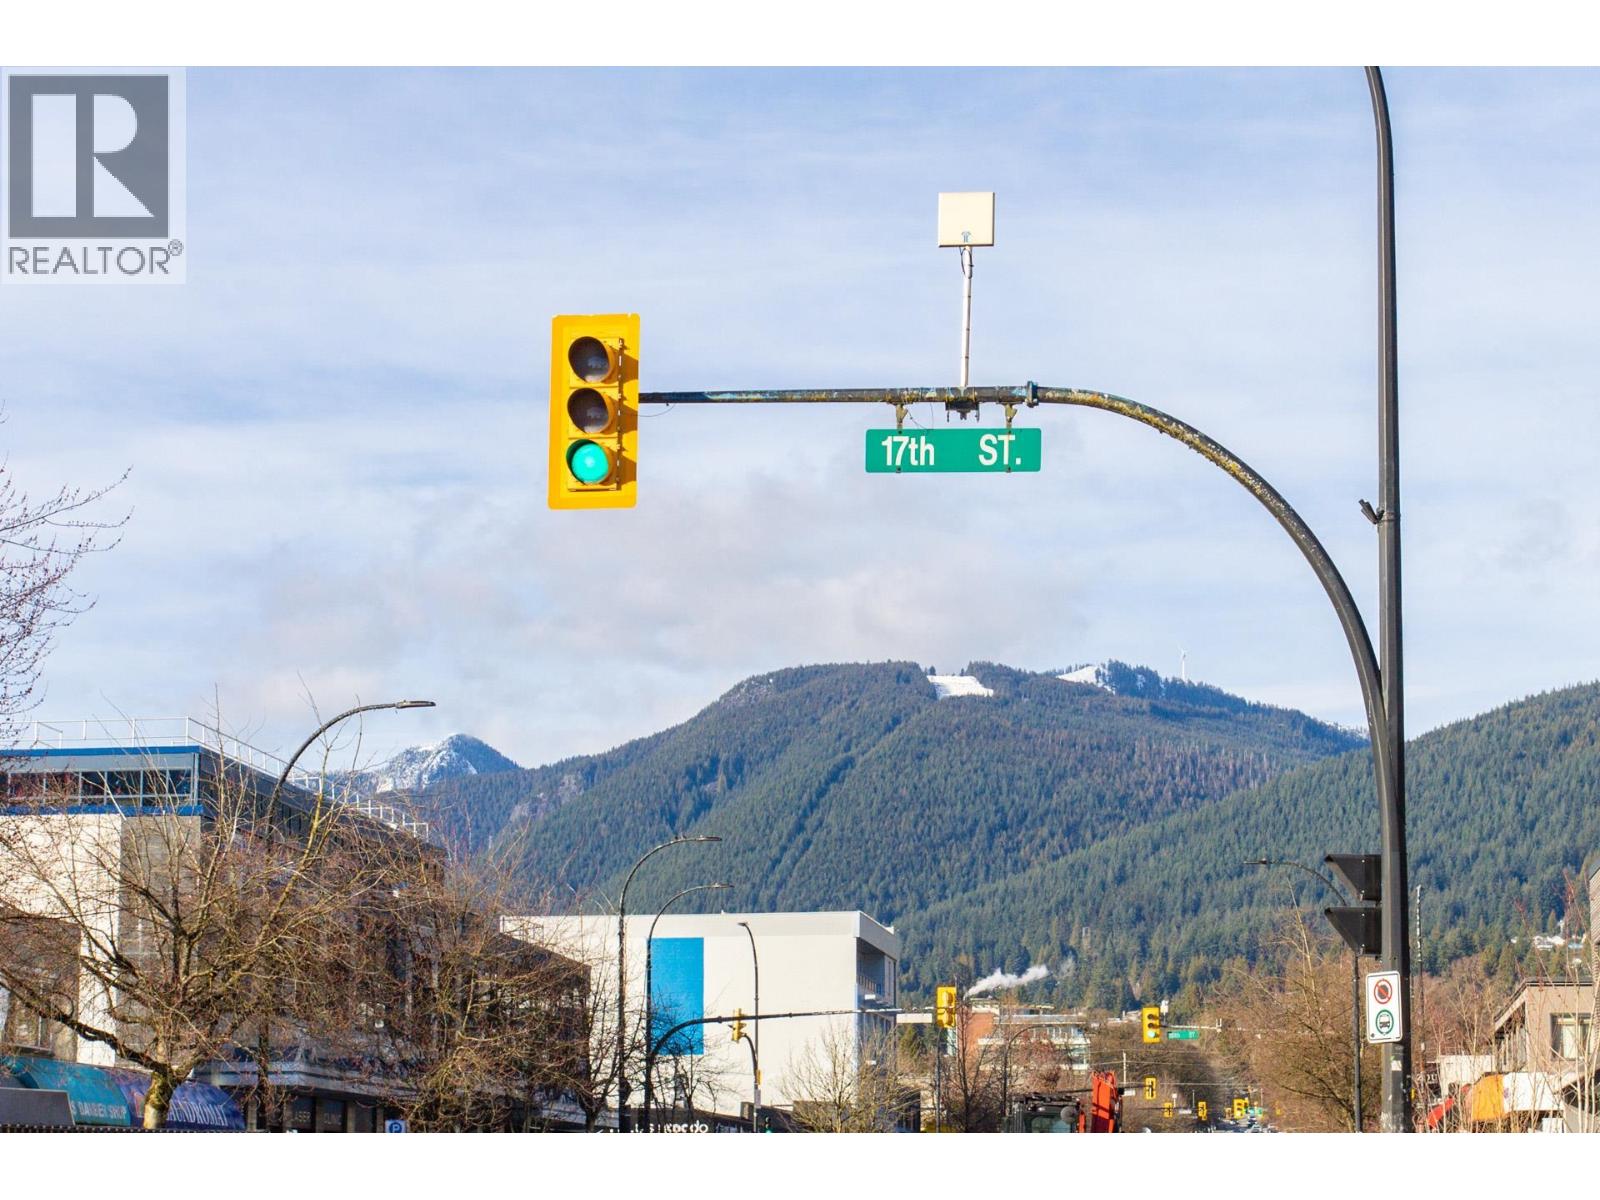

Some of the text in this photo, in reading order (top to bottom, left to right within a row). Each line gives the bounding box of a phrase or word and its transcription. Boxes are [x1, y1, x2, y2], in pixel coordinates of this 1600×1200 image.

[881, 433, 1022, 466] 17th ST.
[166, 1099, 229, 1127] AUNDROMAT
